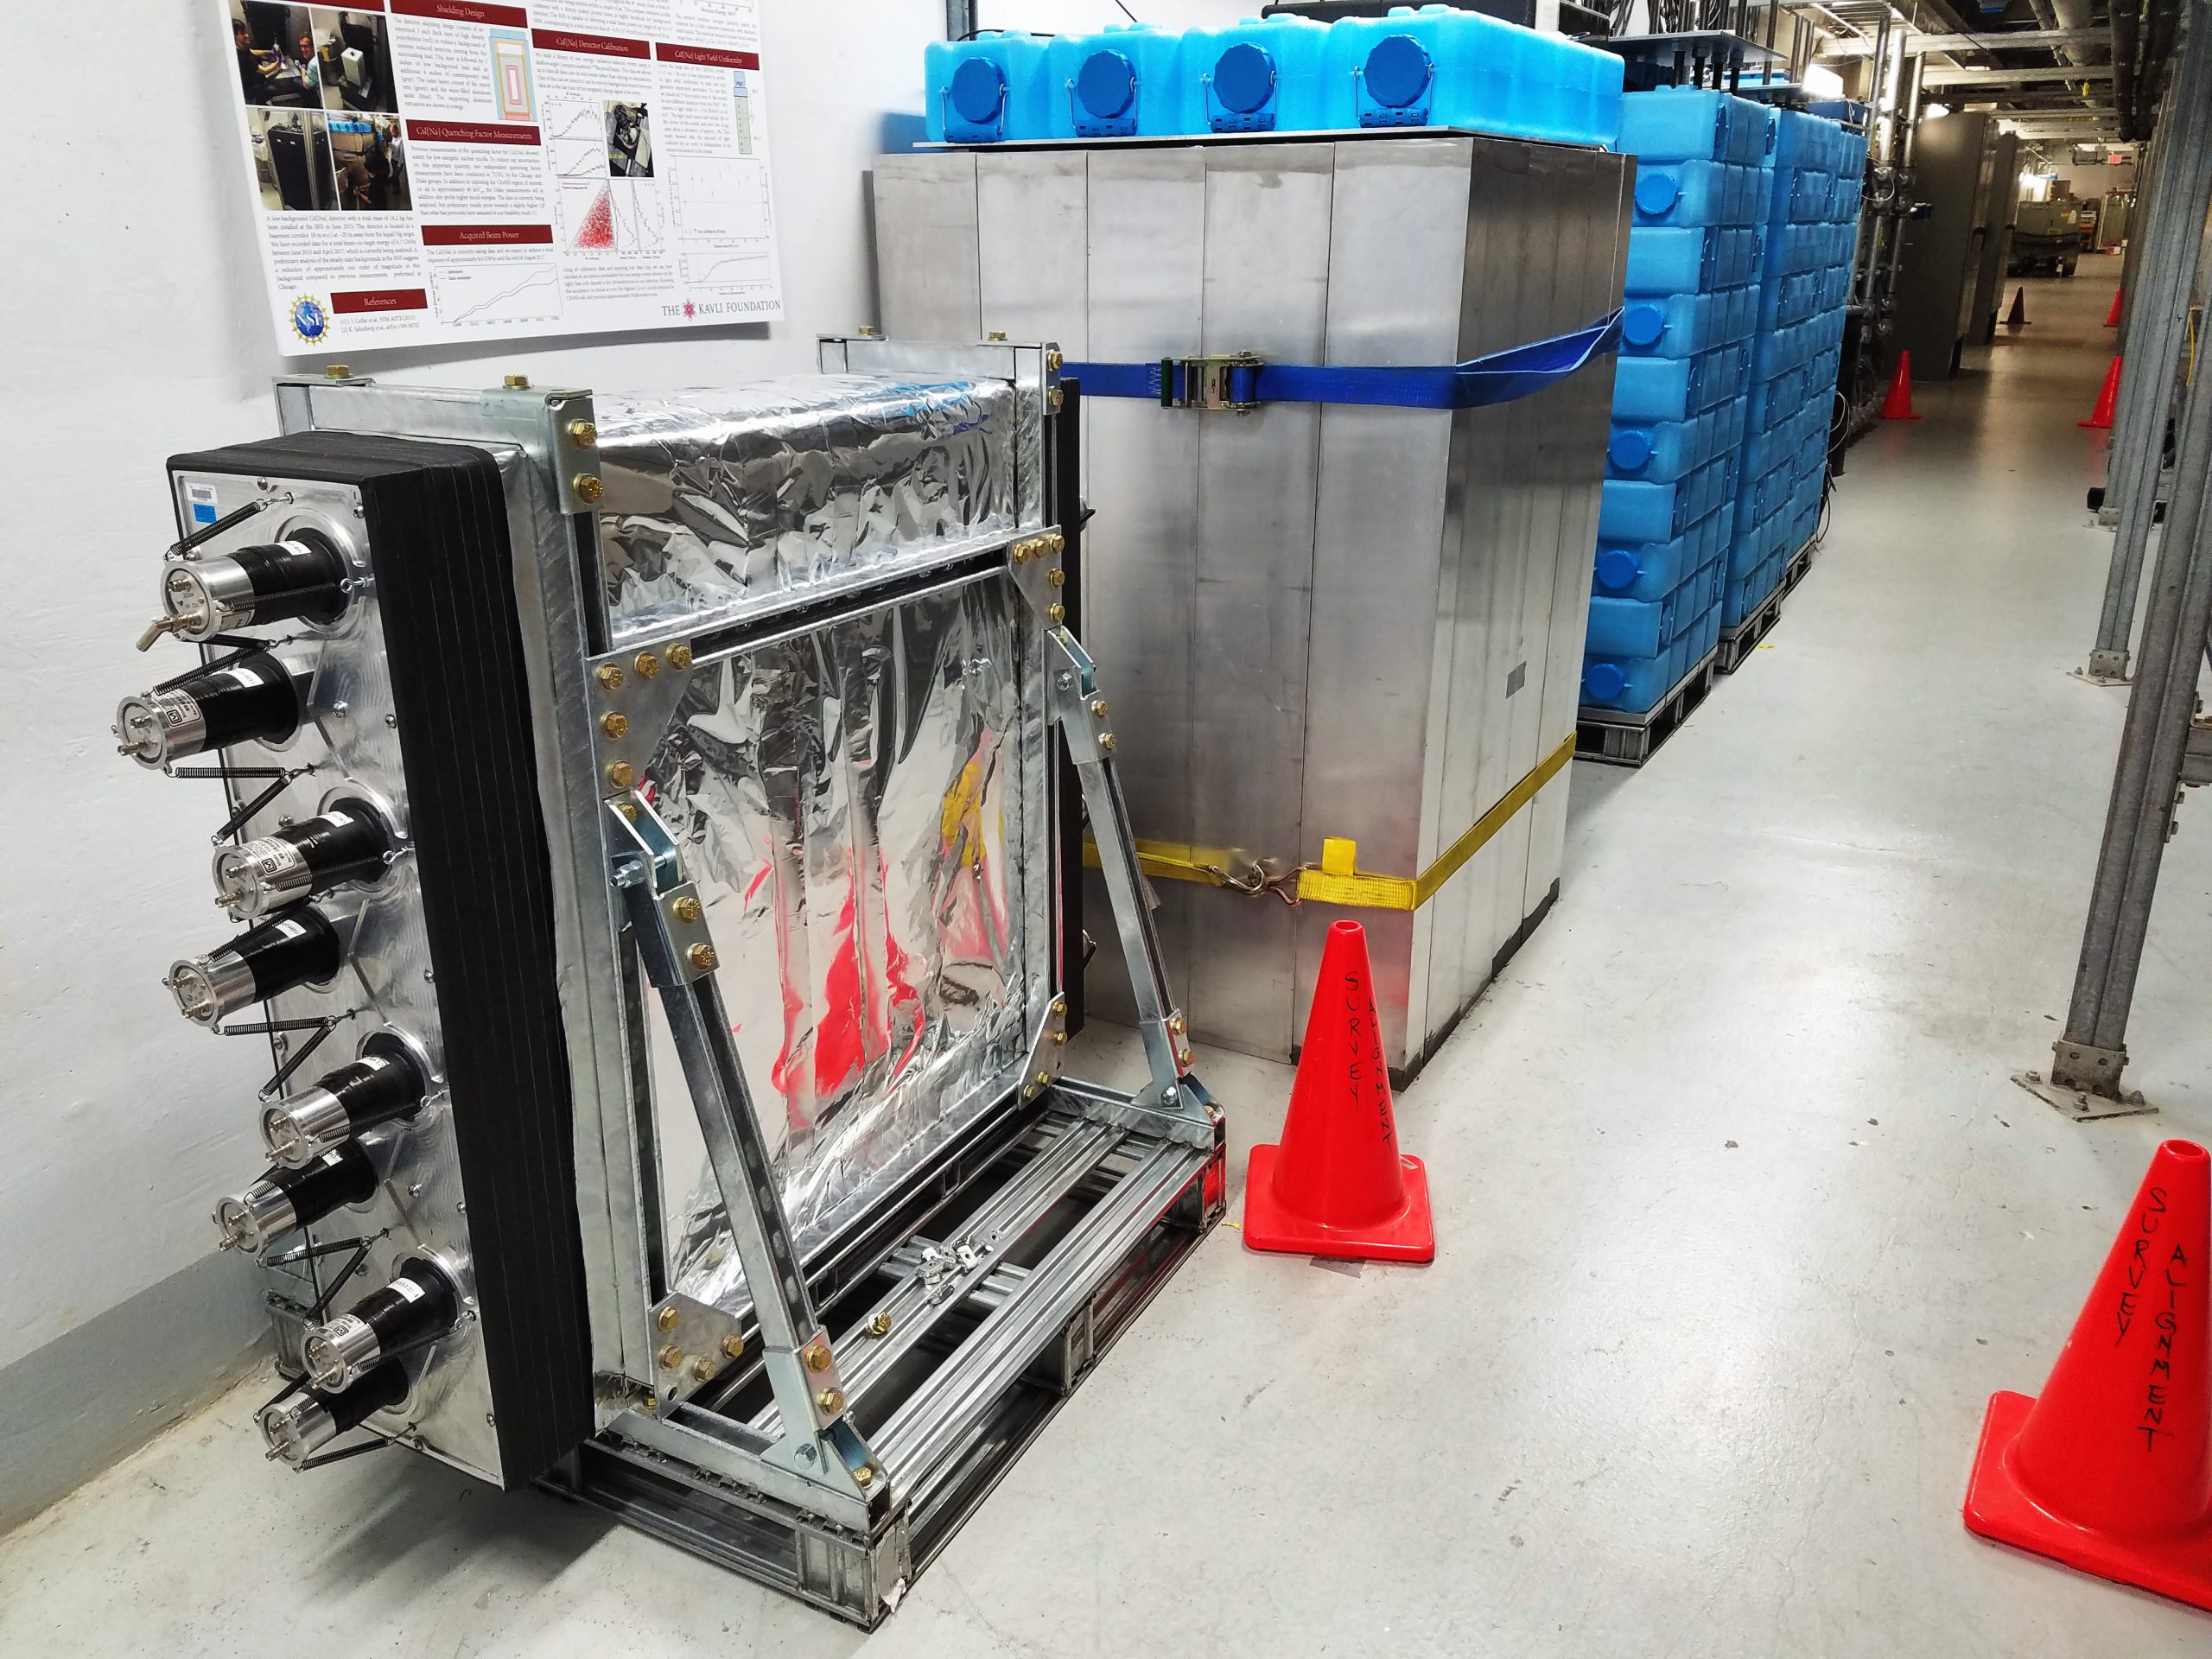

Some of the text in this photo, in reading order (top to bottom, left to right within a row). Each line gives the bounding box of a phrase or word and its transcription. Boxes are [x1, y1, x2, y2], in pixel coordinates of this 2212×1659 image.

[437, 5, 484, 19] Shielding Design
[579, 39, 600, 49] Detector
[601, 41, 629, 52] Calibration
[695, 53, 706, 62] Light
[718, 55, 742, 65] Uniformity
[442, 128, 475, 139] Quenching
[475, 130, 492, 138] Factor
[494, 131, 533, 139] Measurements
[459, 232, 485, 241] Acquired
[661, 300, 781, 316] THE KAVLI FOUNDATION
[296, 312, 321, 327] NSF
[1344, 970, 1362, 1112] SURVEY
[1369, 999, 1392, 1147] ALIGNMENT
[2115, 1187, 2167, 1346] SURVEY
[2137, 1243, 2188, 1452] ALIGNMENT
